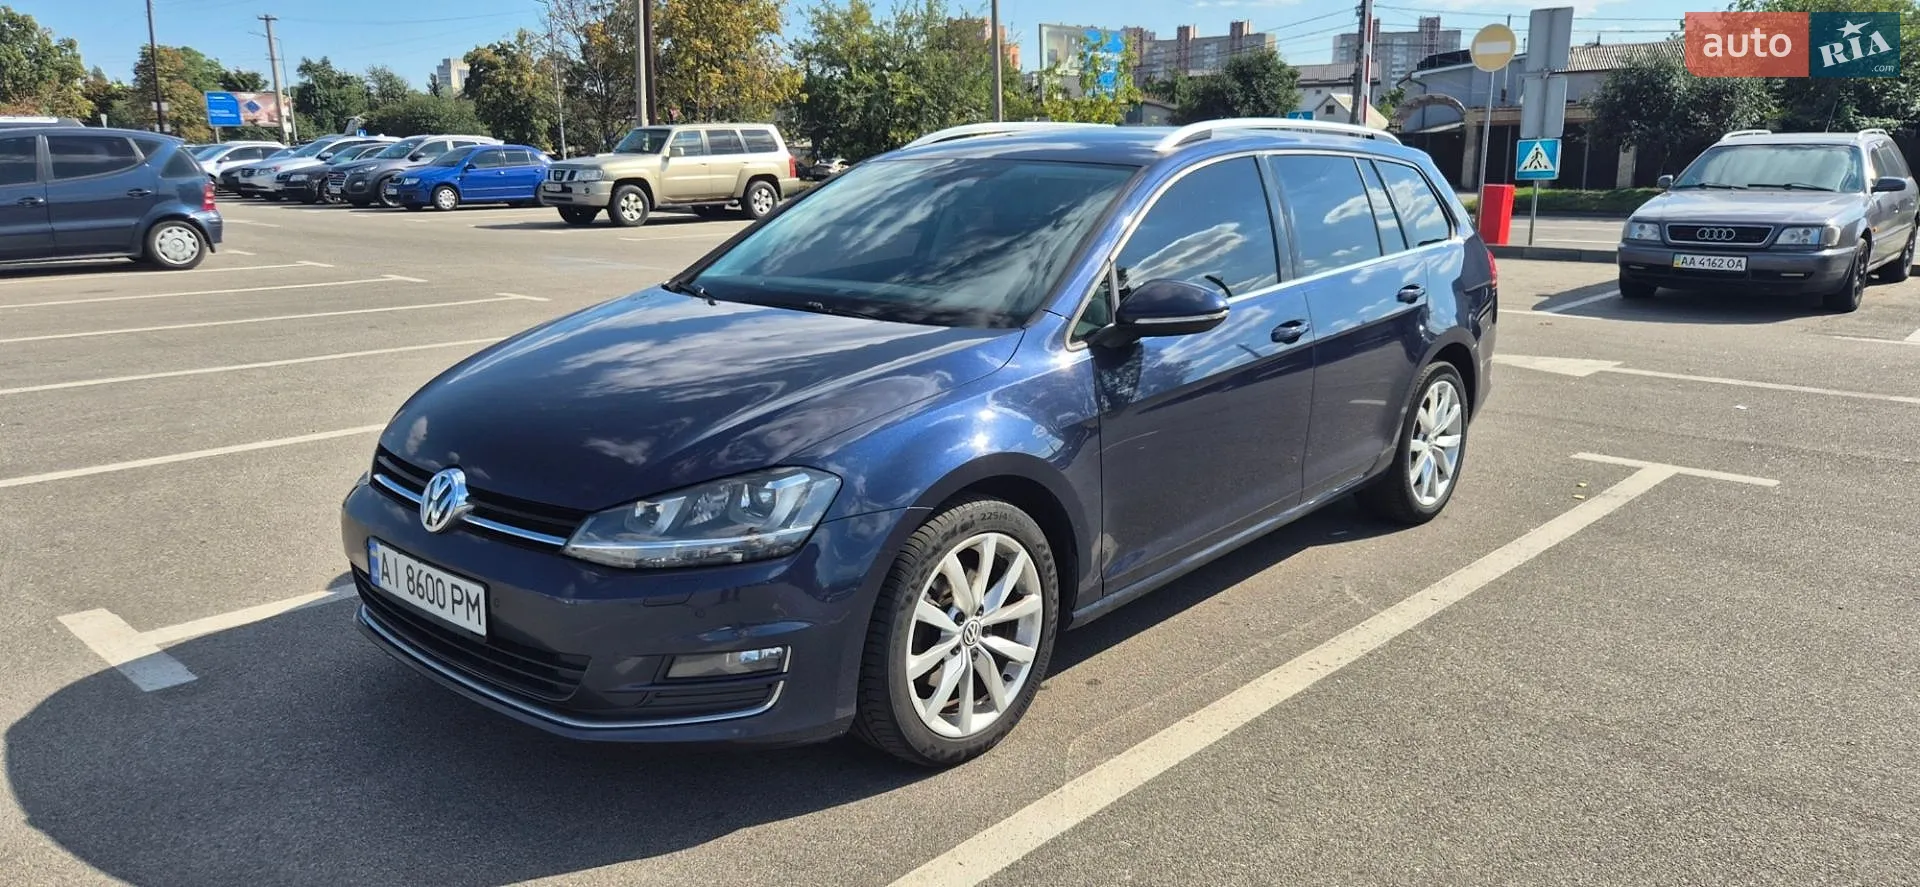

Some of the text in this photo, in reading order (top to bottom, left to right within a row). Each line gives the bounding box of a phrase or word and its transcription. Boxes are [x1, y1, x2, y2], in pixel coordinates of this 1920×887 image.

[1681, 256, 1743, 269] AA 4162 OA
[381, 551, 482, 626] AI 8600 PM
